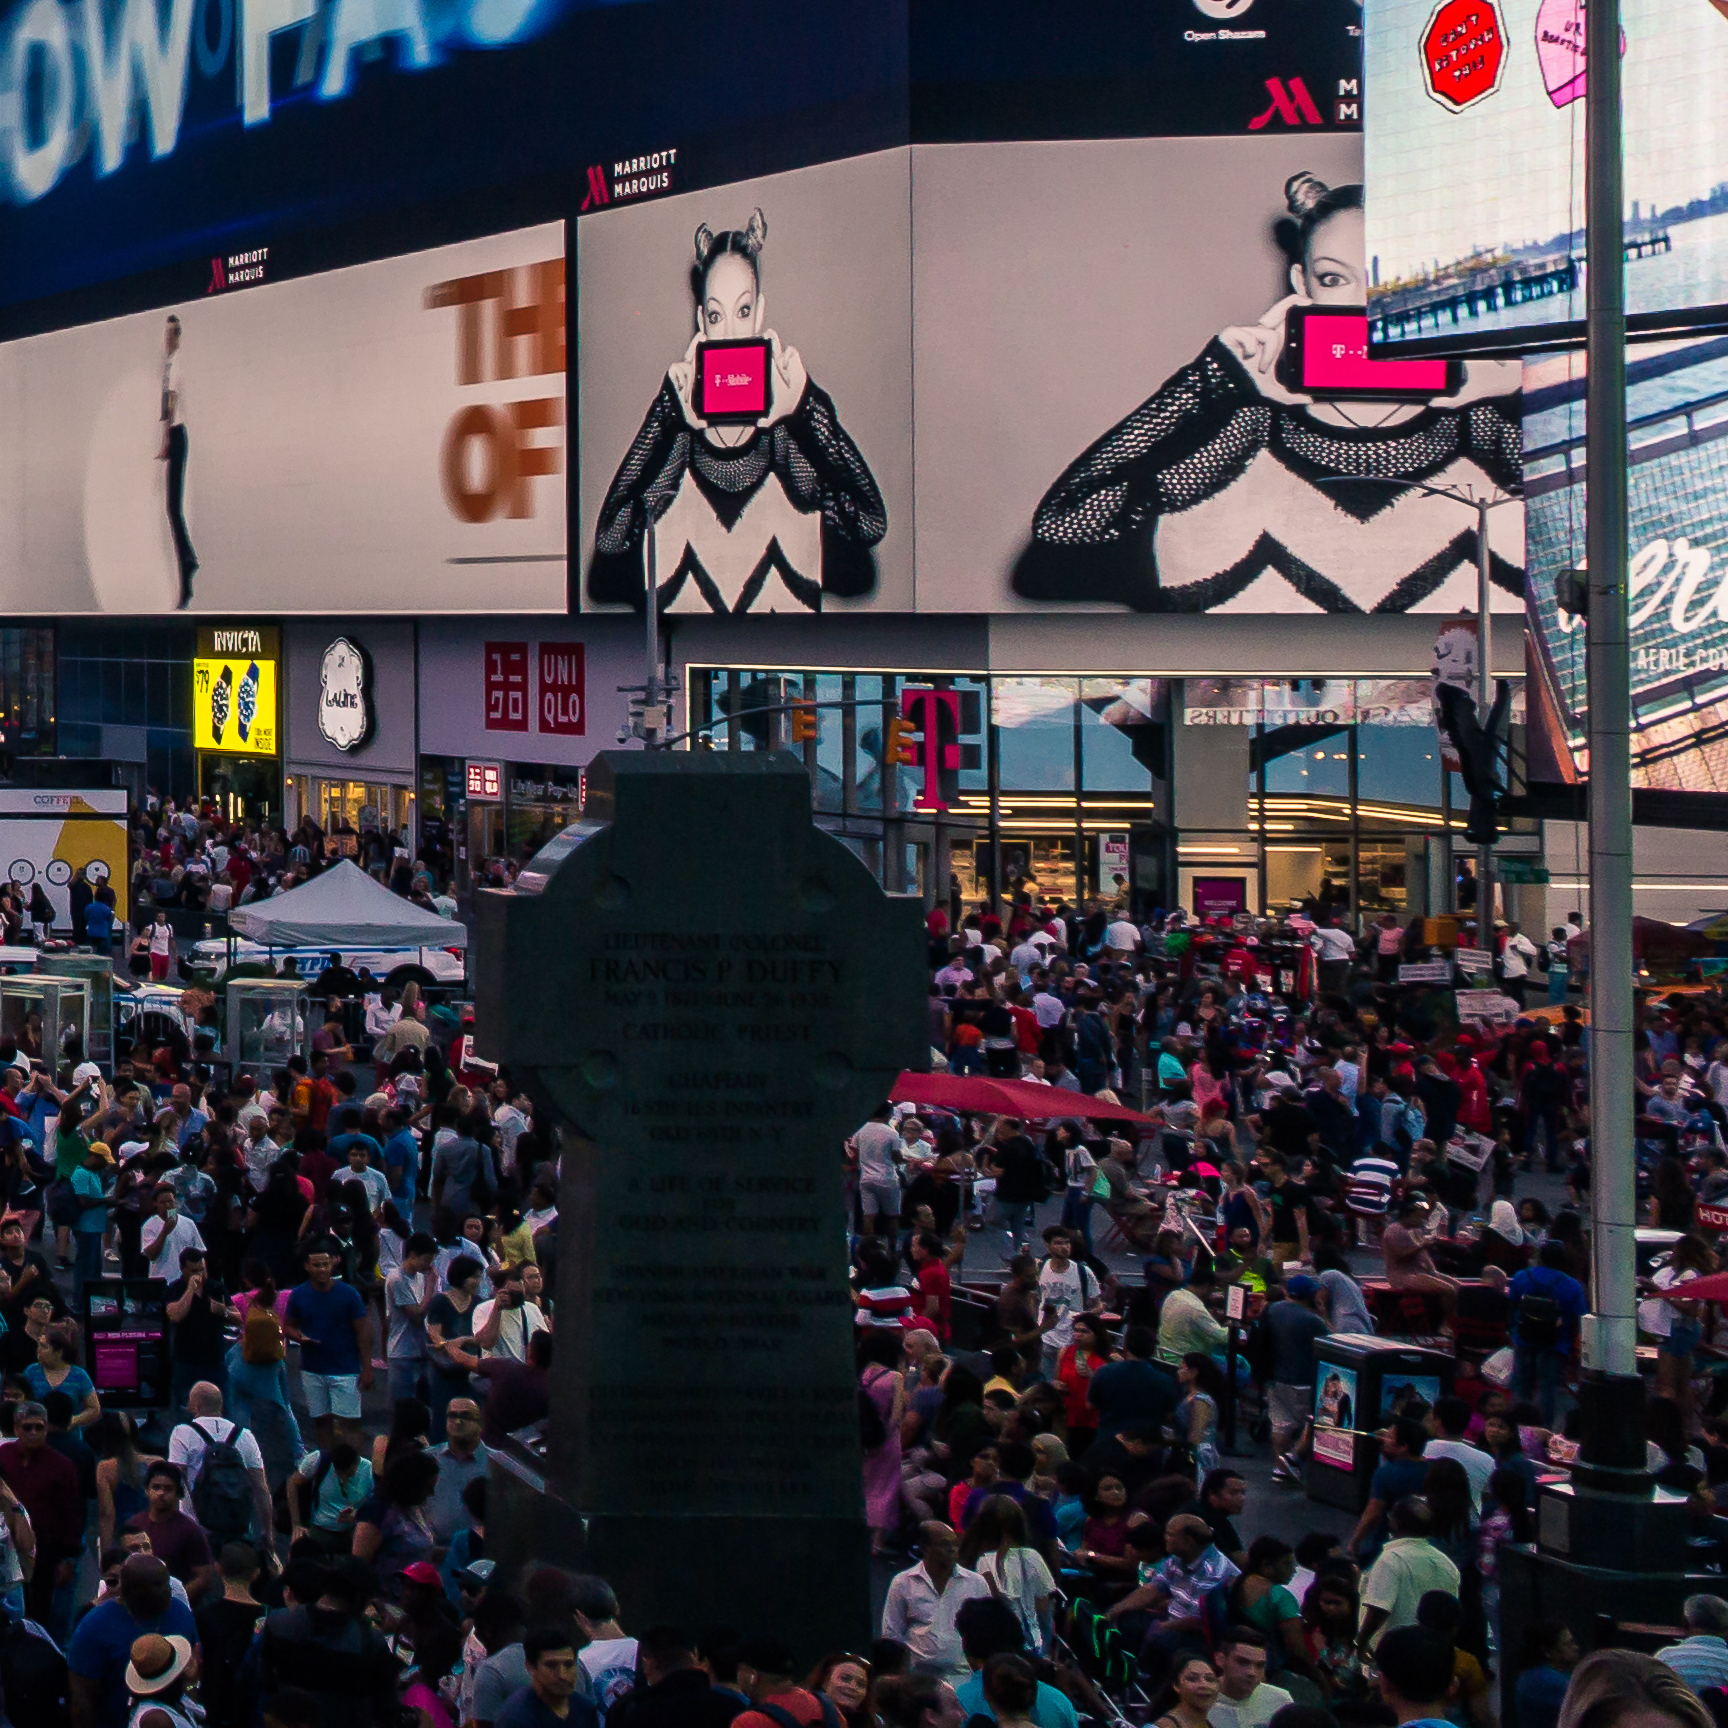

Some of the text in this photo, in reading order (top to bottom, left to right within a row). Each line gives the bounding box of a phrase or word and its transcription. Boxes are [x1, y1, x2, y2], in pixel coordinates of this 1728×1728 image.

[1184, 30, 1216, 42] Open
[1440, 12, 1480, 48] CAN'T
[1452, 56, 1486, 84] THIS
[614, 149, 678, 178] MARRIOTT
[614, 171, 670, 200] MARQUIS
[228, 248, 269, 269] MARRIOTT
[228, 264, 265, 285] MARQUIS
[214, 630, 262, 654] INVICTA
[544, 653, 578, 683] UNI
[544, 691, 578, 724] QLO
[589, 959, 846, 983] FRANCIS P DUFFY
[622, 1022, 813, 1040] CATHOLIC PRIEST
[734, 1177, 816, 1193] SERVICE
